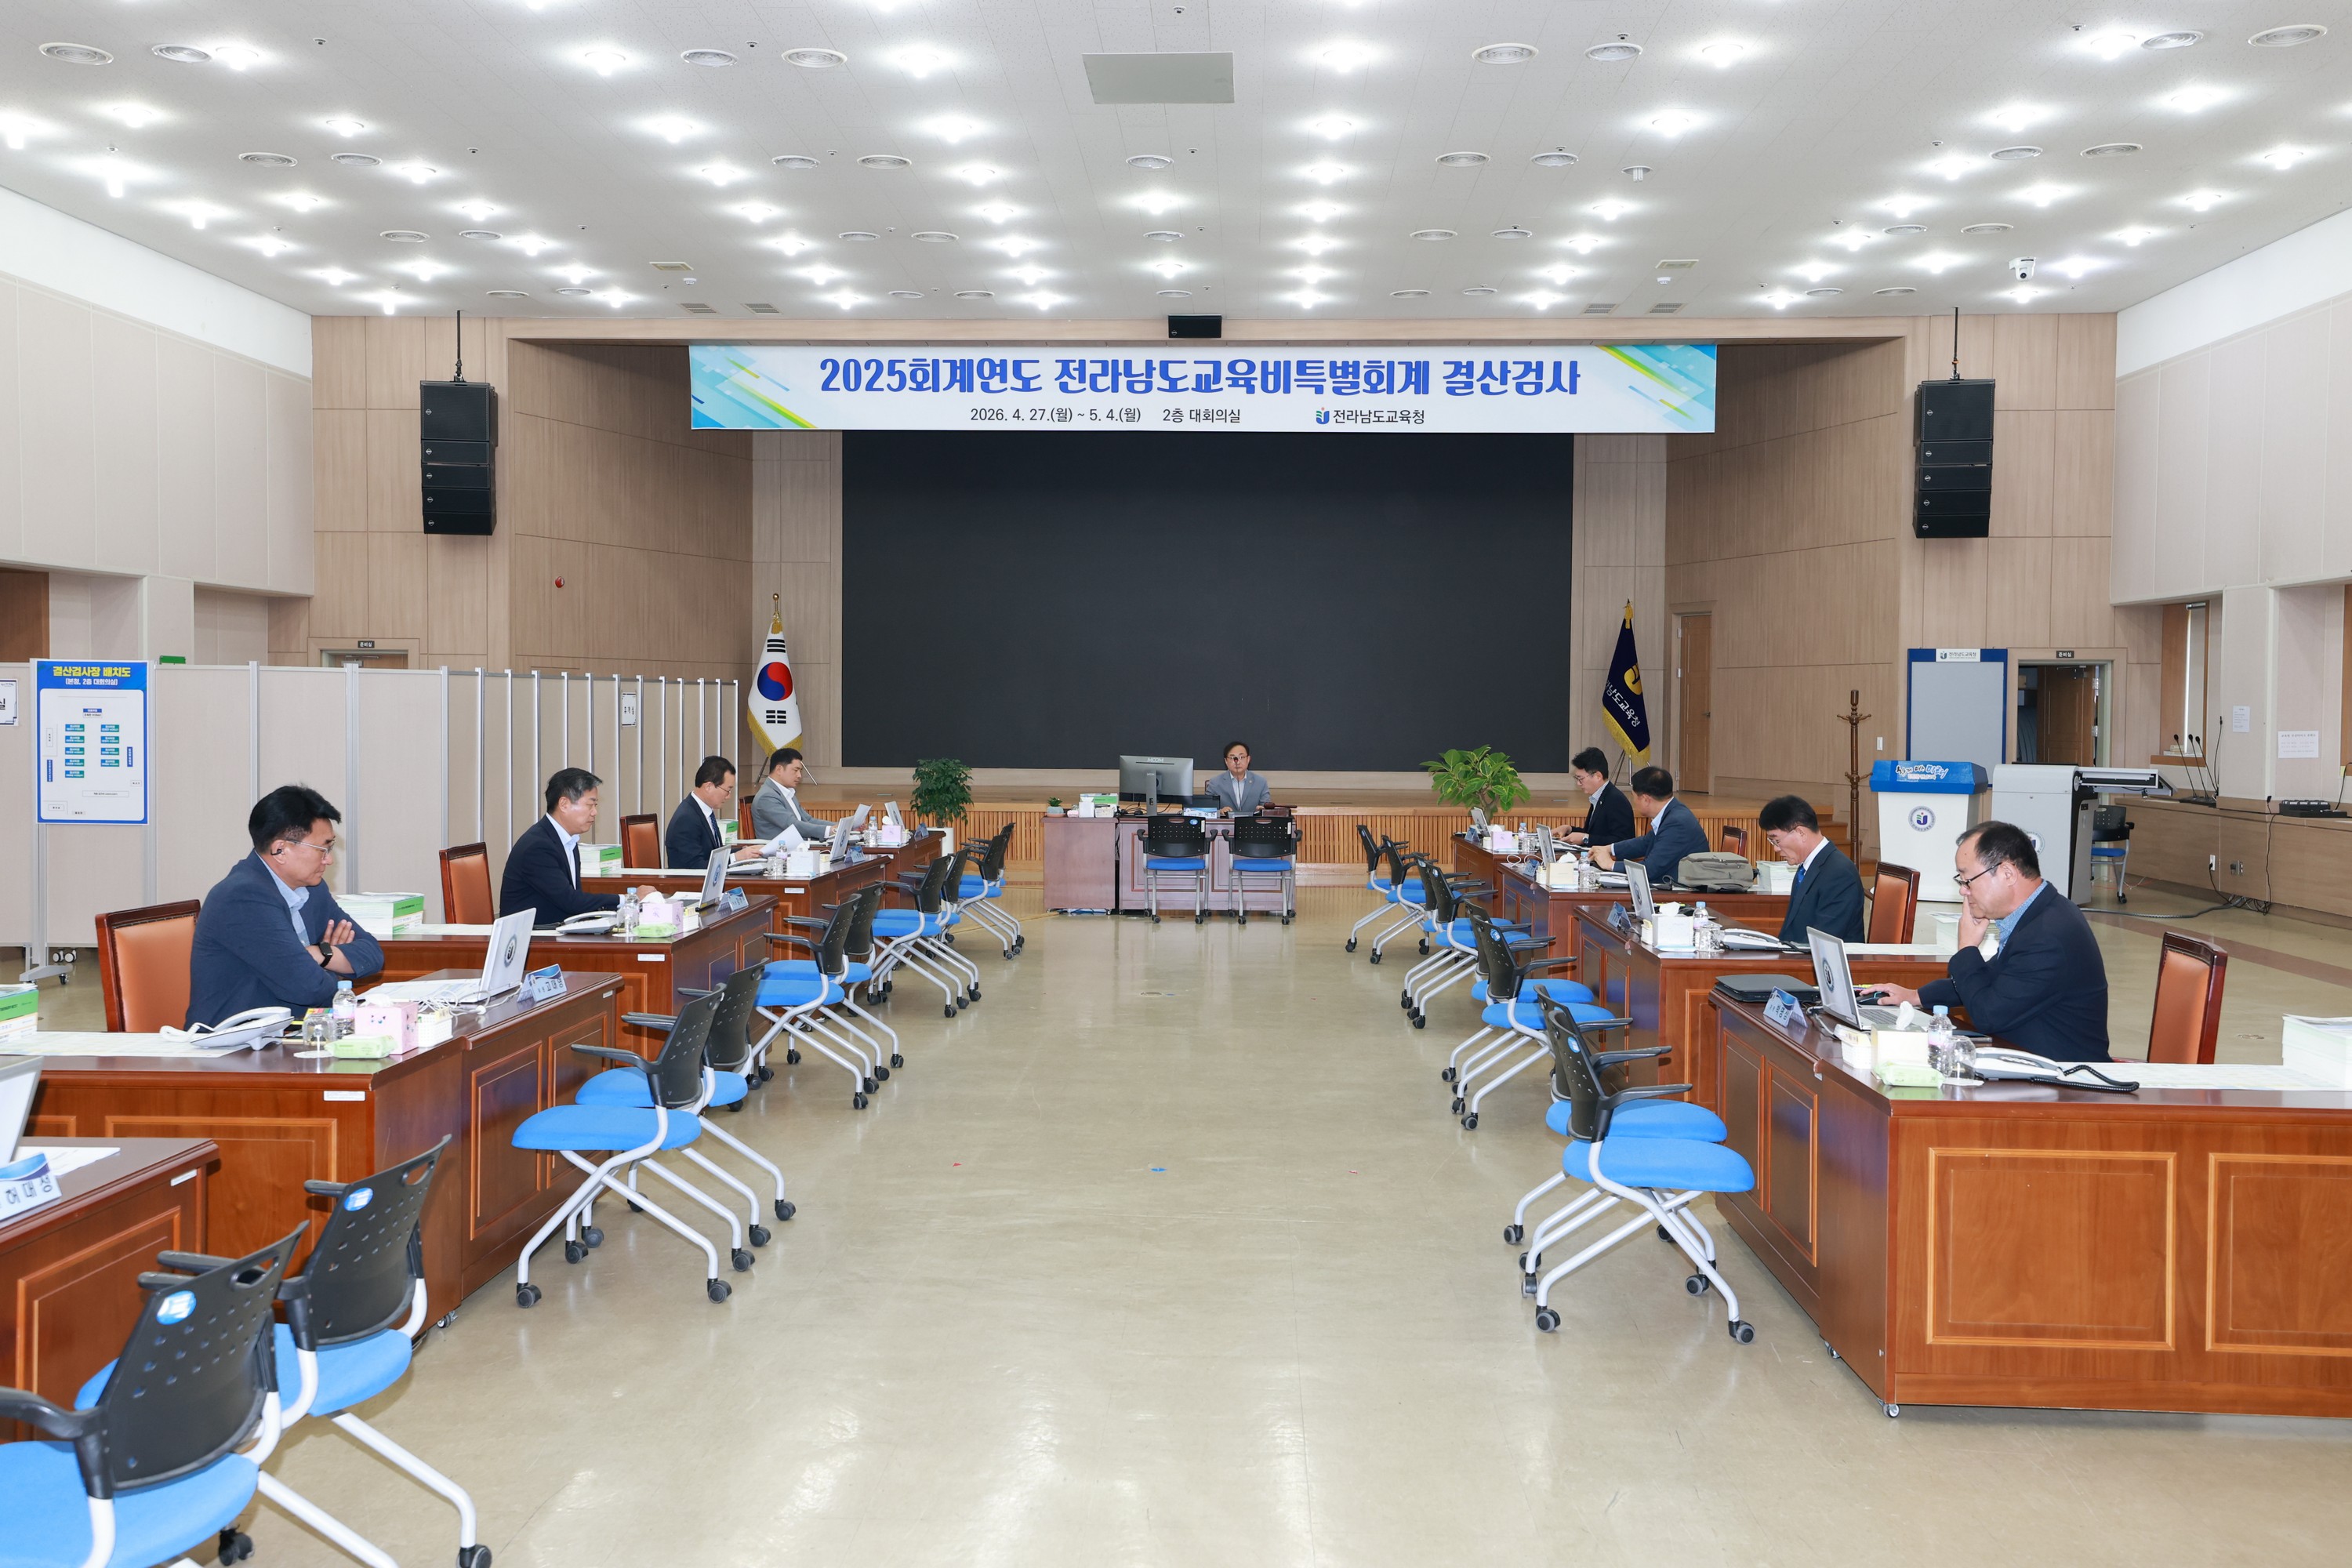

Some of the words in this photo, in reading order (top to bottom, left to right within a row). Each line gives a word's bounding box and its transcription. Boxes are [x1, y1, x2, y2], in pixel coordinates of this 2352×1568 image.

[819, 358, 1042, 394] 2025회계연도
[1054, 358, 1430, 396] 전라남도교육비특별회계
[1443, 360, 1581, 397] 결산검사
[971, 408, 1008, 421] 2026.
[1012, 408, 1025, 421] 4.
[1029, 407, 1073, 423] 27.(월)
[1090, 408, 1102, 422] 5.
[1105, 407, 1142, 423] 4.(월)
[1163, 408, 1185, 423] 2층
[1189, 408, 1240, 423] 대회의실
[1333, 409, 1425, 425] 전라남도교육청
[53, 666, 101, 677] 결산검사장
[103, 667, 131, 677] 배치도
